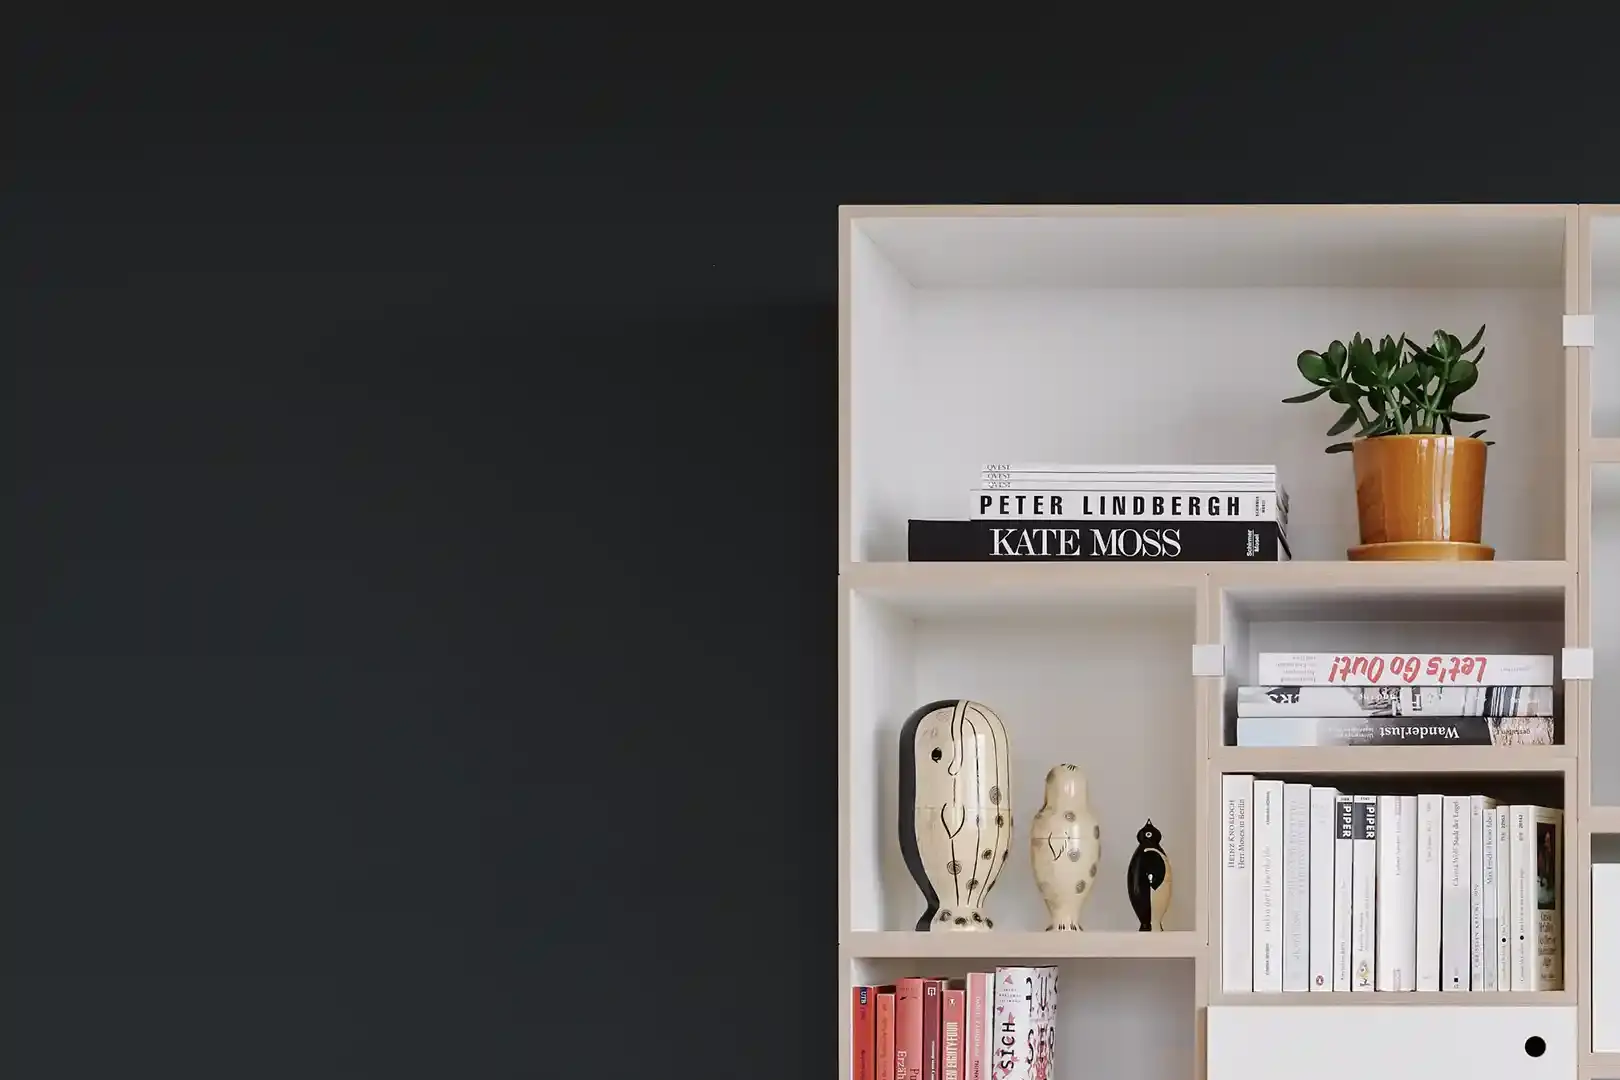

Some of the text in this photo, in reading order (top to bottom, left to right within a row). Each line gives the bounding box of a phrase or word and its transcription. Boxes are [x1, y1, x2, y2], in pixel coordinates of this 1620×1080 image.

[980, 495, 1240, 516] PETER LINDBERGH
[989, 528, 1182, 557] KATE MOSS
[1328, 656, 1385, 684] Out!
[1390, 656, 1421, 684] Go
[1427, 656, 1487, 684] Let's
[1379, 726, 1460, 739] Wanderlust
[1237, 799, 1245, 820] Berlin
[1342, 804, 1352, 838] PIPER
[1366, 805, 1376, 839] PIPER
[1237, 829, 1245, 852] Moses
[1237, 853, 1245, 869] Herr
[1001, 1022, 1016, 1069] SICH
